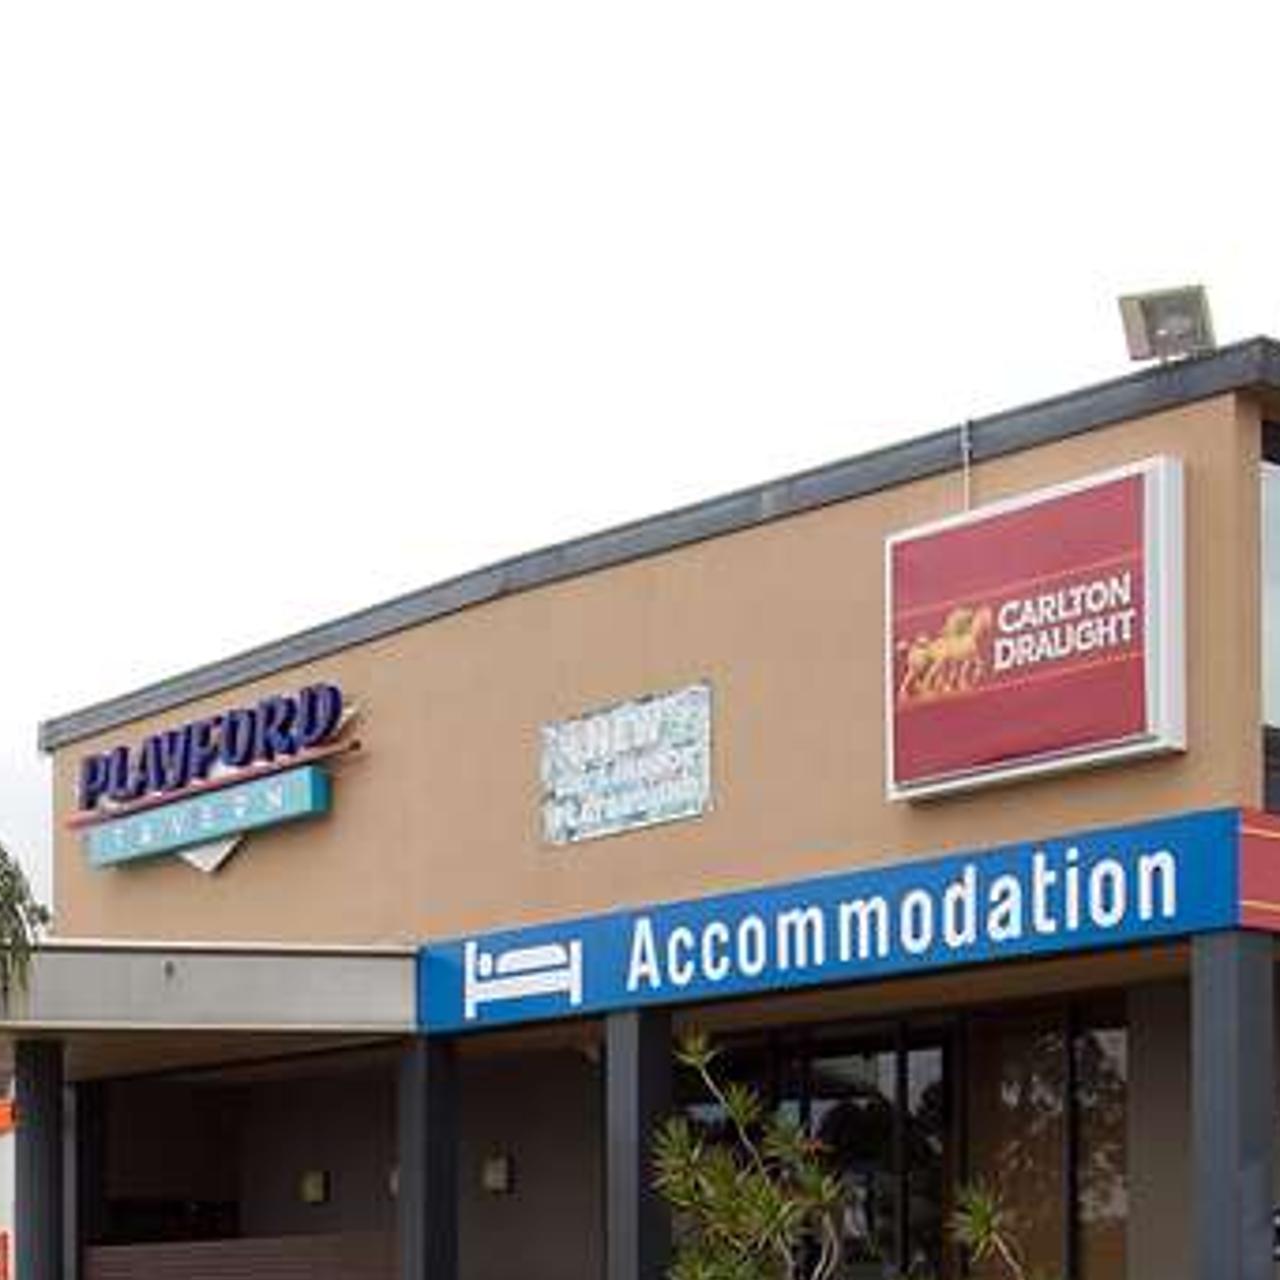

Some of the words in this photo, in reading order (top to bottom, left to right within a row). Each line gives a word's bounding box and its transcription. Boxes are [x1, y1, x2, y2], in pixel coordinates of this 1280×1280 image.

[992, 607, 1137, 671] DRAUGHT
[996, 570, 1132, 632] CARLTON
[78, 682, 343, 811] PLAYFORD
[625, 846, 1177, 992] Accommodation
